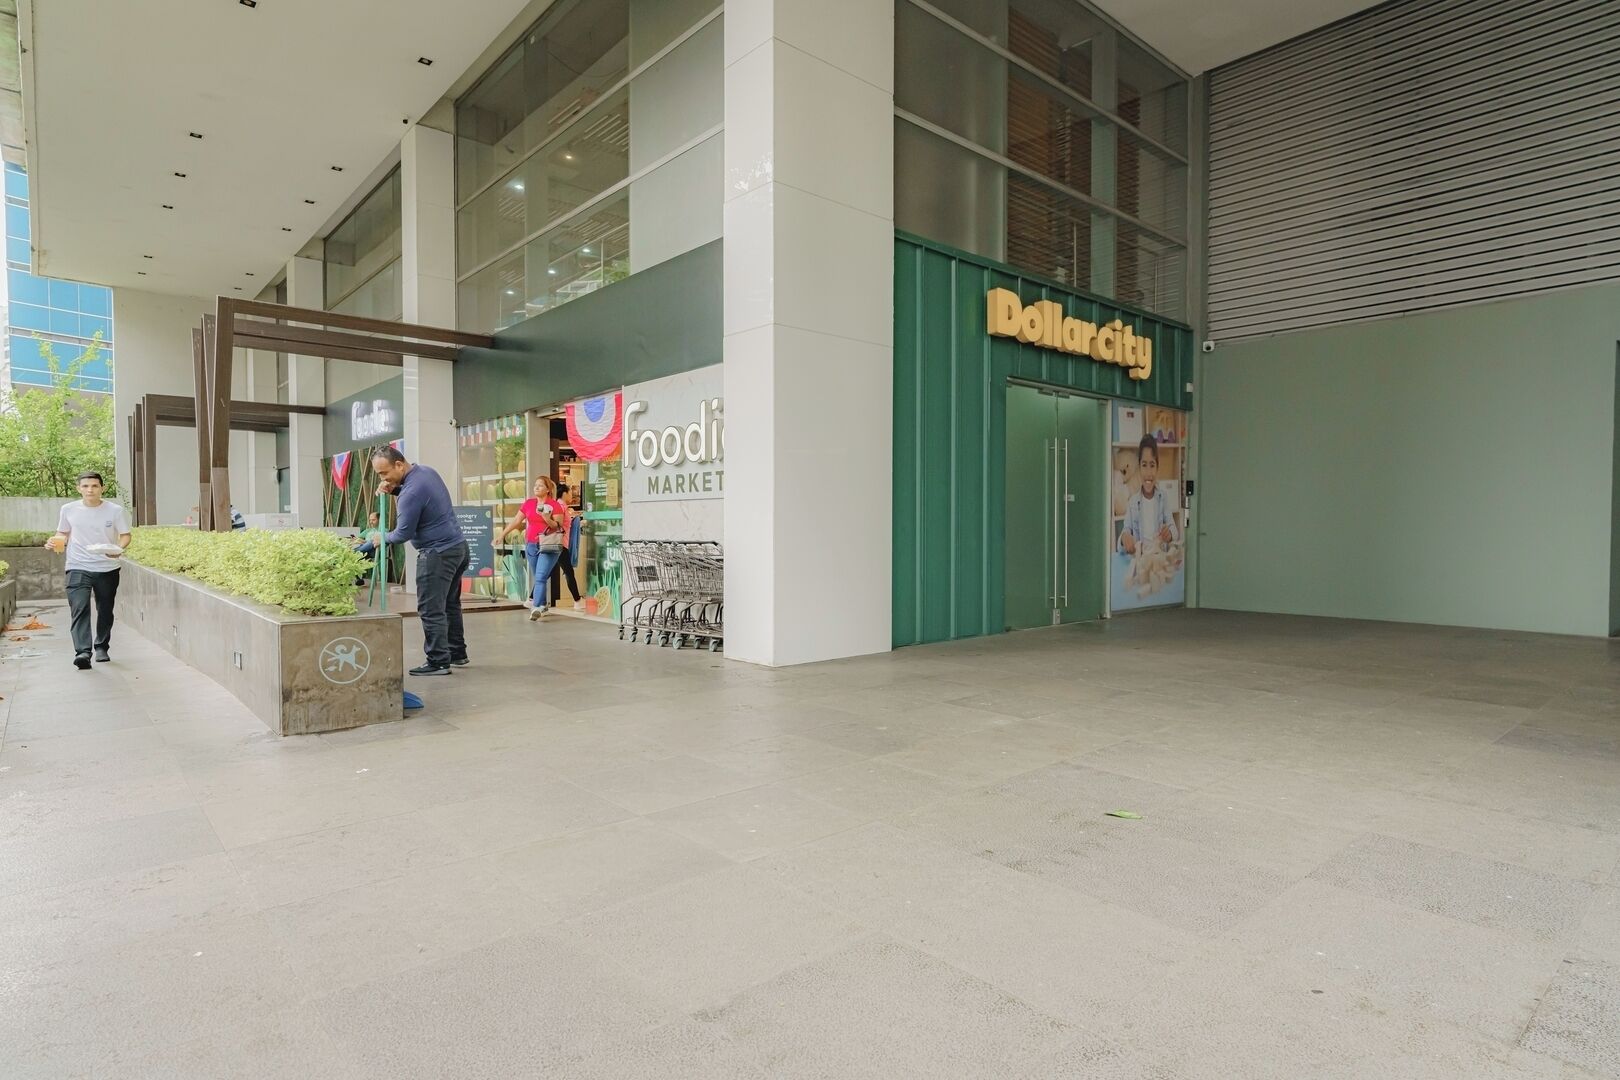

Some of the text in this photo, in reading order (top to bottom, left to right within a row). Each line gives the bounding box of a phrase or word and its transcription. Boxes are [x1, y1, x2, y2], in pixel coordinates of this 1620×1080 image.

[987, 287, 1153, 380] Dollarcity
[624, 397, 724, 469] foodi
[647, 471, 724, 495] MARKET
